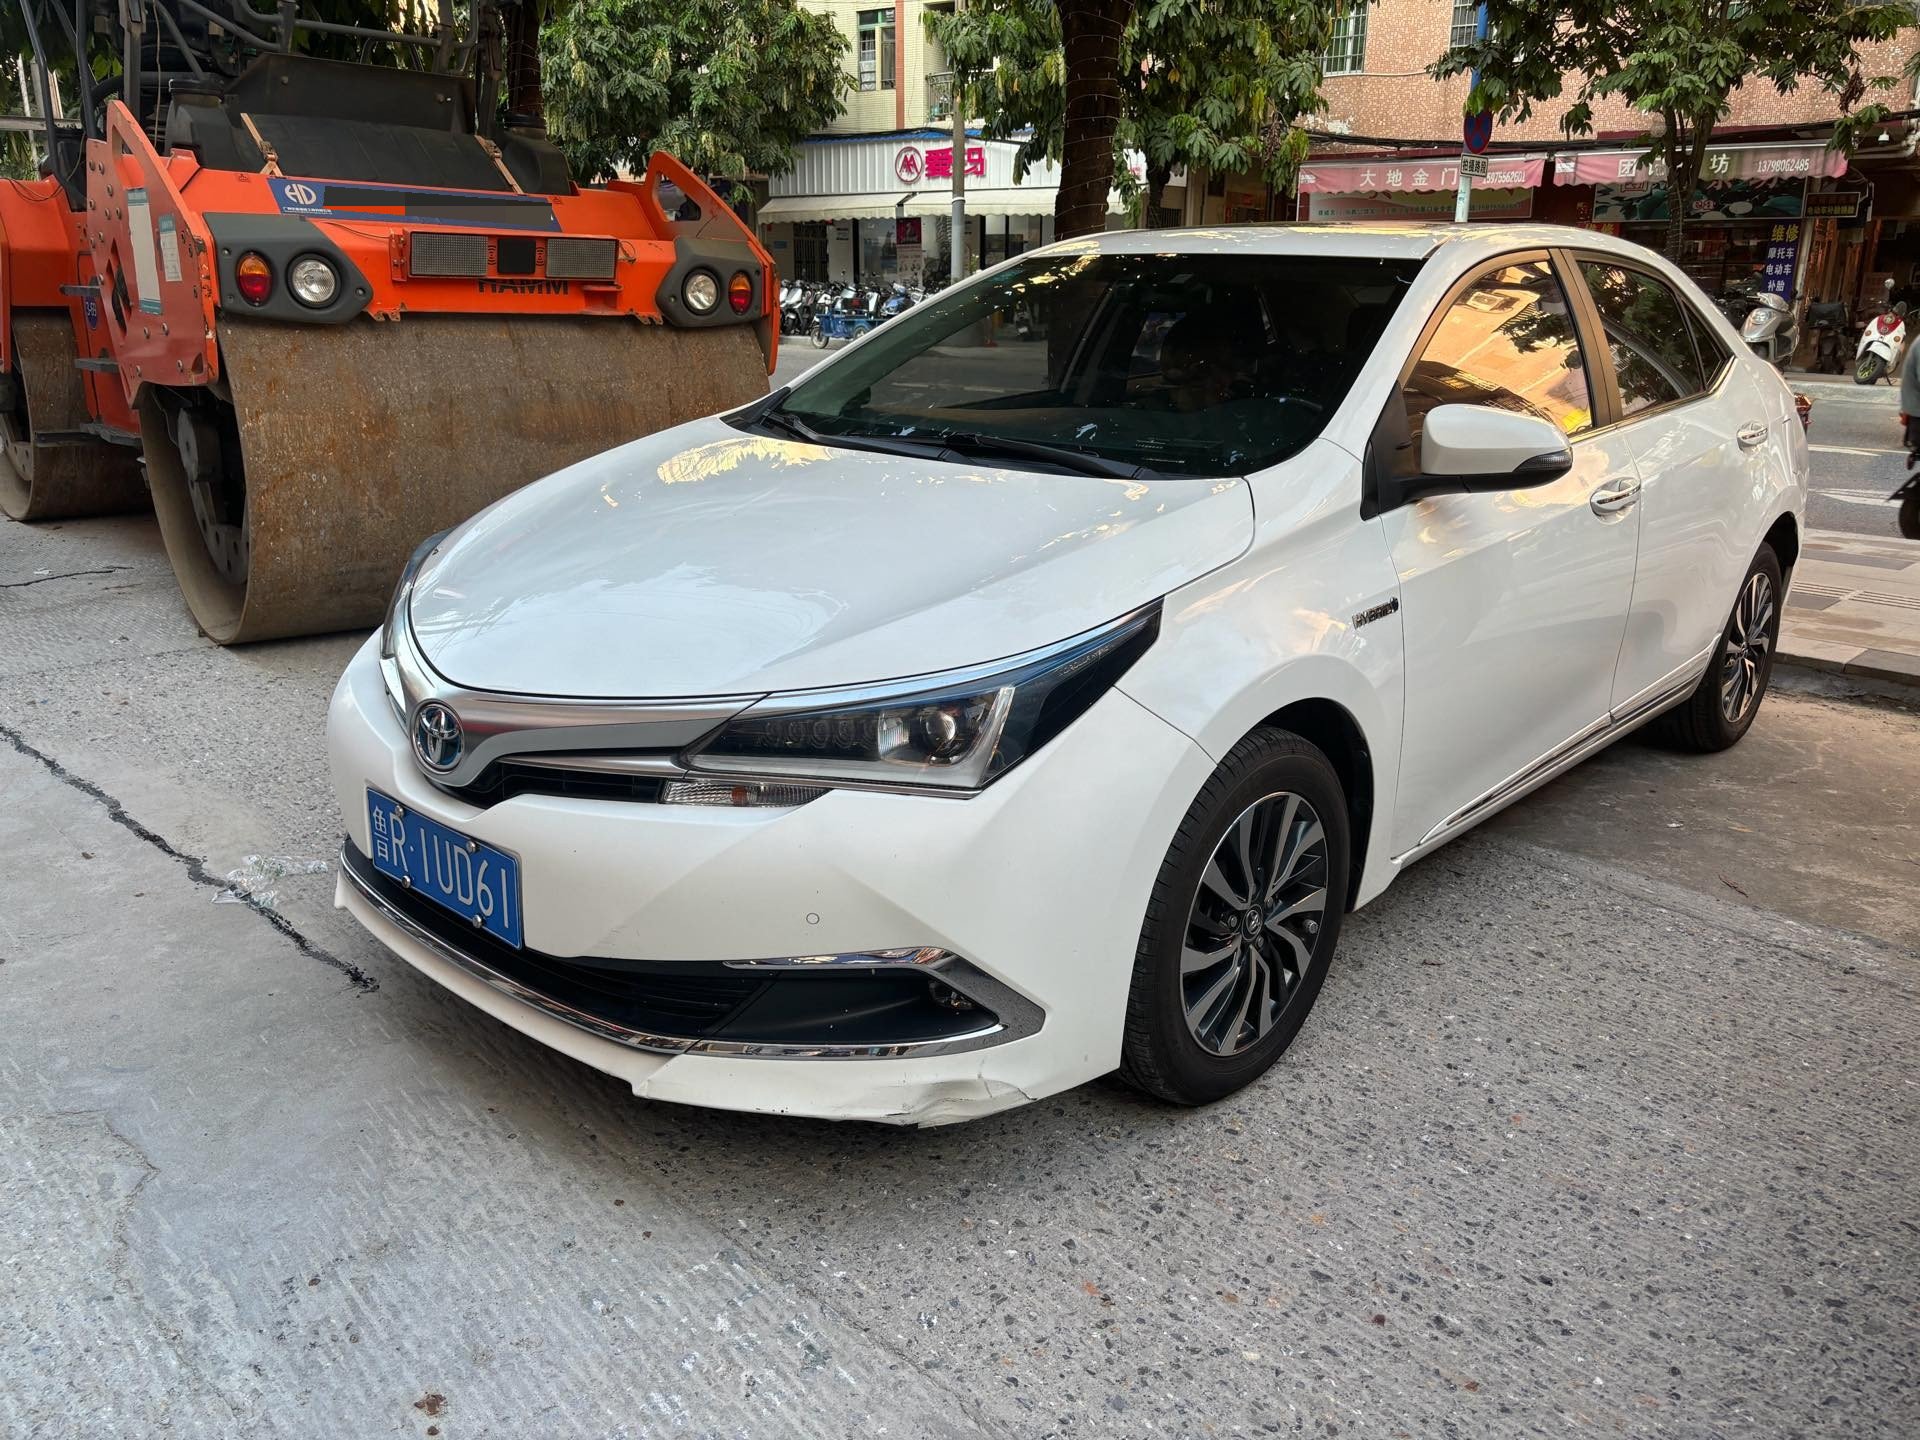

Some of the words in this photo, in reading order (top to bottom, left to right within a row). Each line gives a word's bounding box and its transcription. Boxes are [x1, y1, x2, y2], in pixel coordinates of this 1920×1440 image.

[1771, 224, 1799, 242] 维修
[1768, 247, 1794, 259] 摩托车
[1766, 263, 1792, 275] 电动车
[1767, 280, 1785, 292] 补胎
